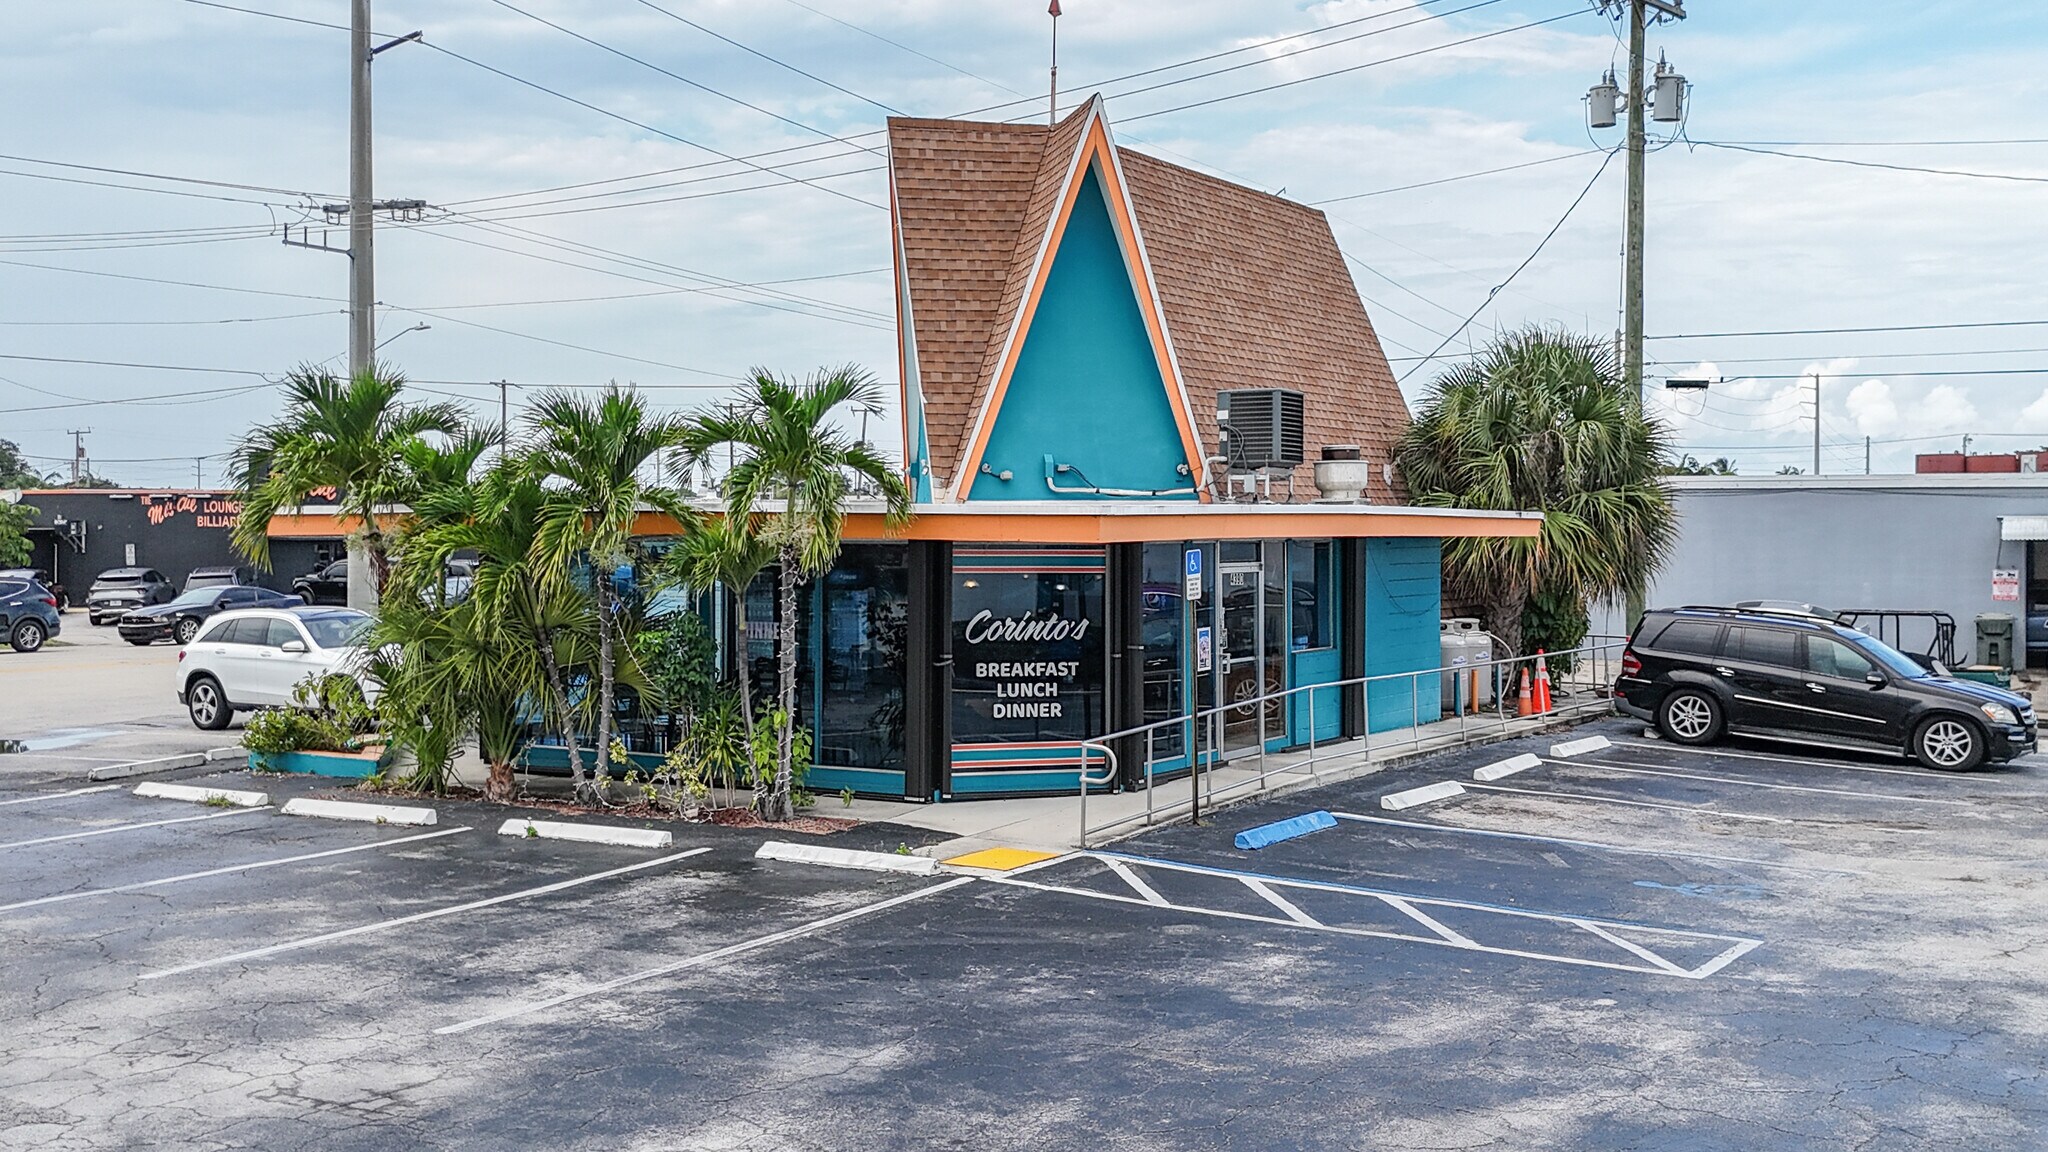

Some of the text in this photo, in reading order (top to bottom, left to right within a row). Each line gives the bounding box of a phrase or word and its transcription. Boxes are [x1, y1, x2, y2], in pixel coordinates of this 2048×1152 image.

[965, 609, 1090, 644] Corinto's
[975, 661, 1080, 678] BREAKFAST
[997, 682, 1058, 698] LUNCH
[992, 702, 1063, 719] DINNER
